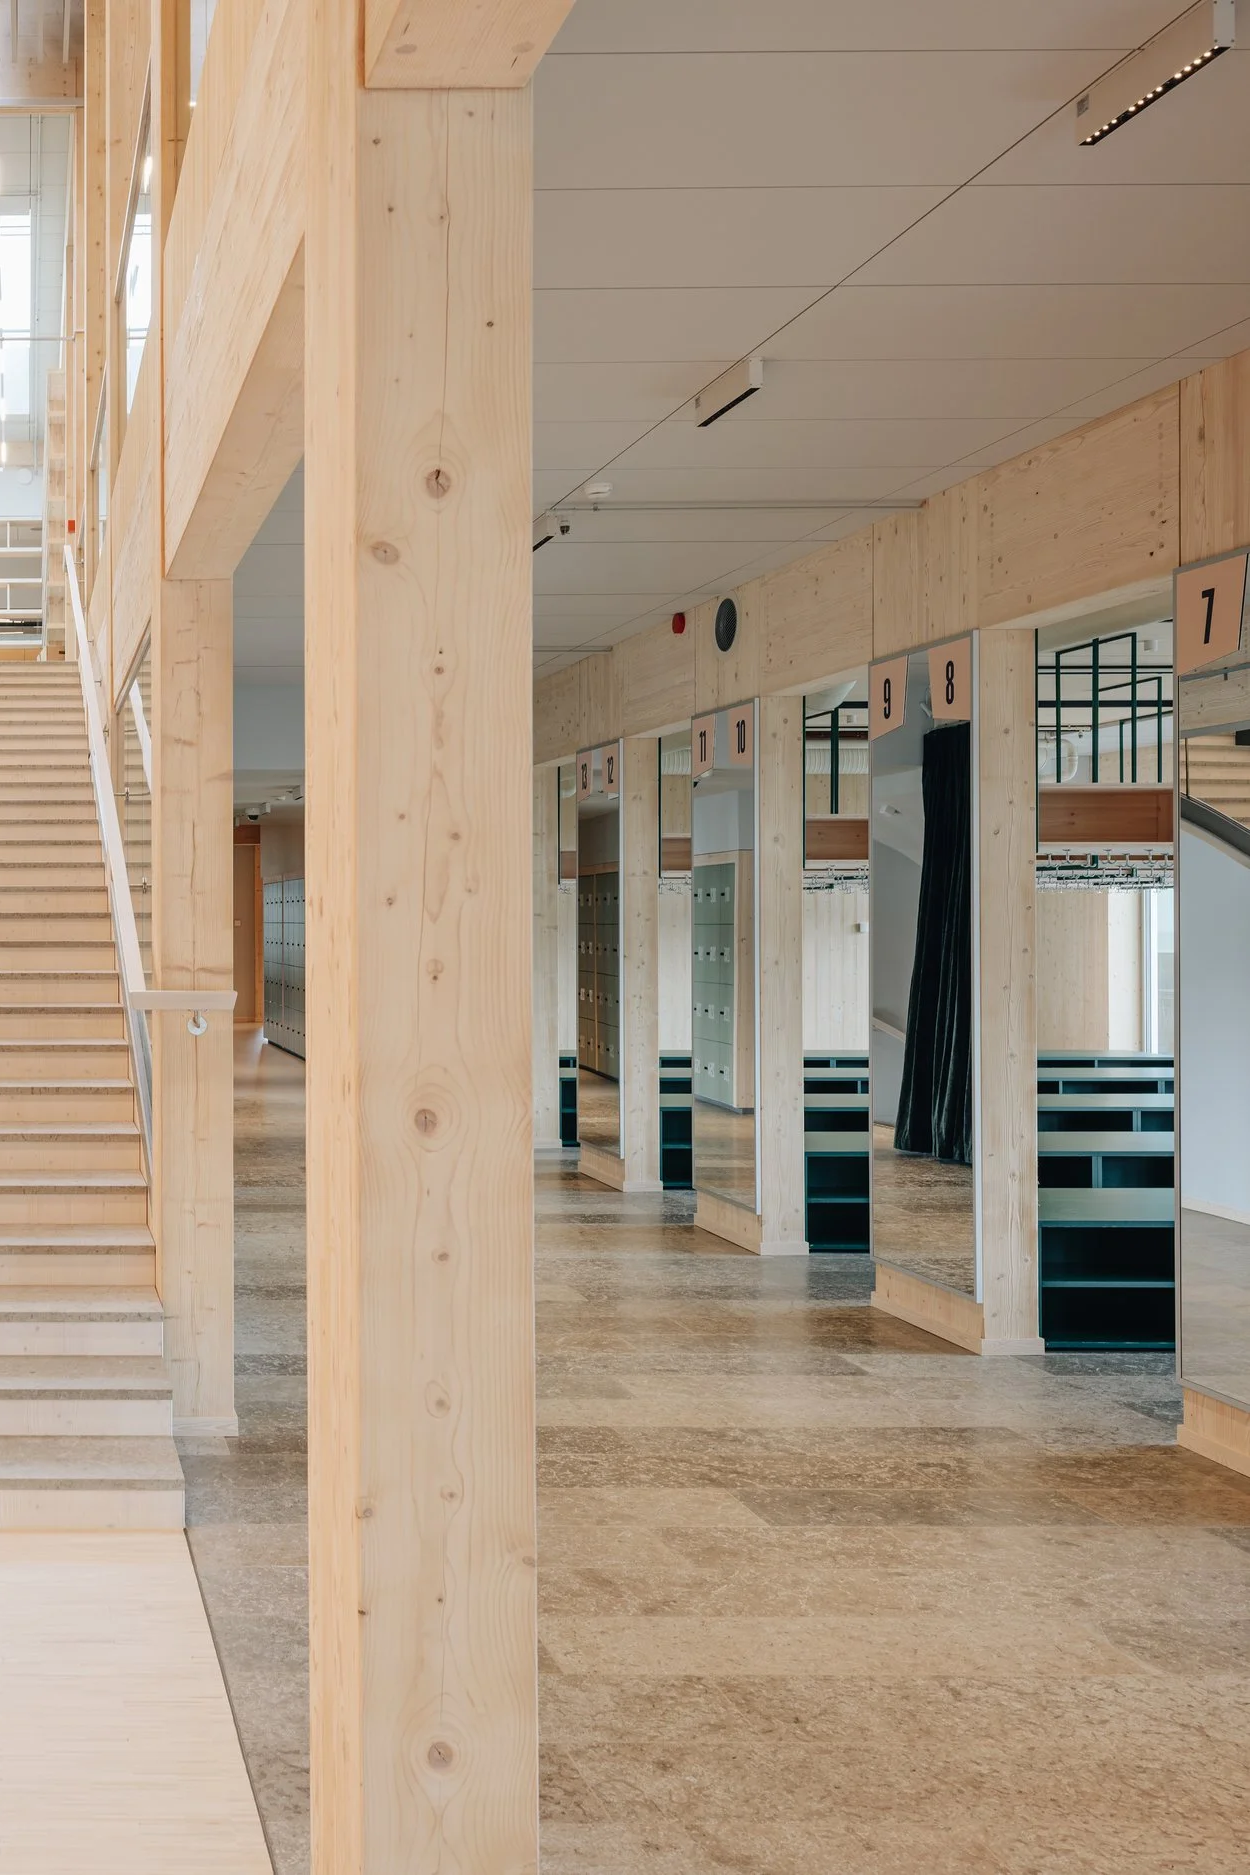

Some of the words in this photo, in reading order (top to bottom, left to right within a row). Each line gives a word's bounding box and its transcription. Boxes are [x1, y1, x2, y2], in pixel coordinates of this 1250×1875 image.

[1201, 587, 1215, 645] 7
[883, 678, 891, 720] 9
[945, 660, 954, 705] 8
[699, 730, 707, 763] 11
[736, 719, 746, 754] 10
[581, 763, 588, 790] 13
[607, 756, 614, 785] 12
